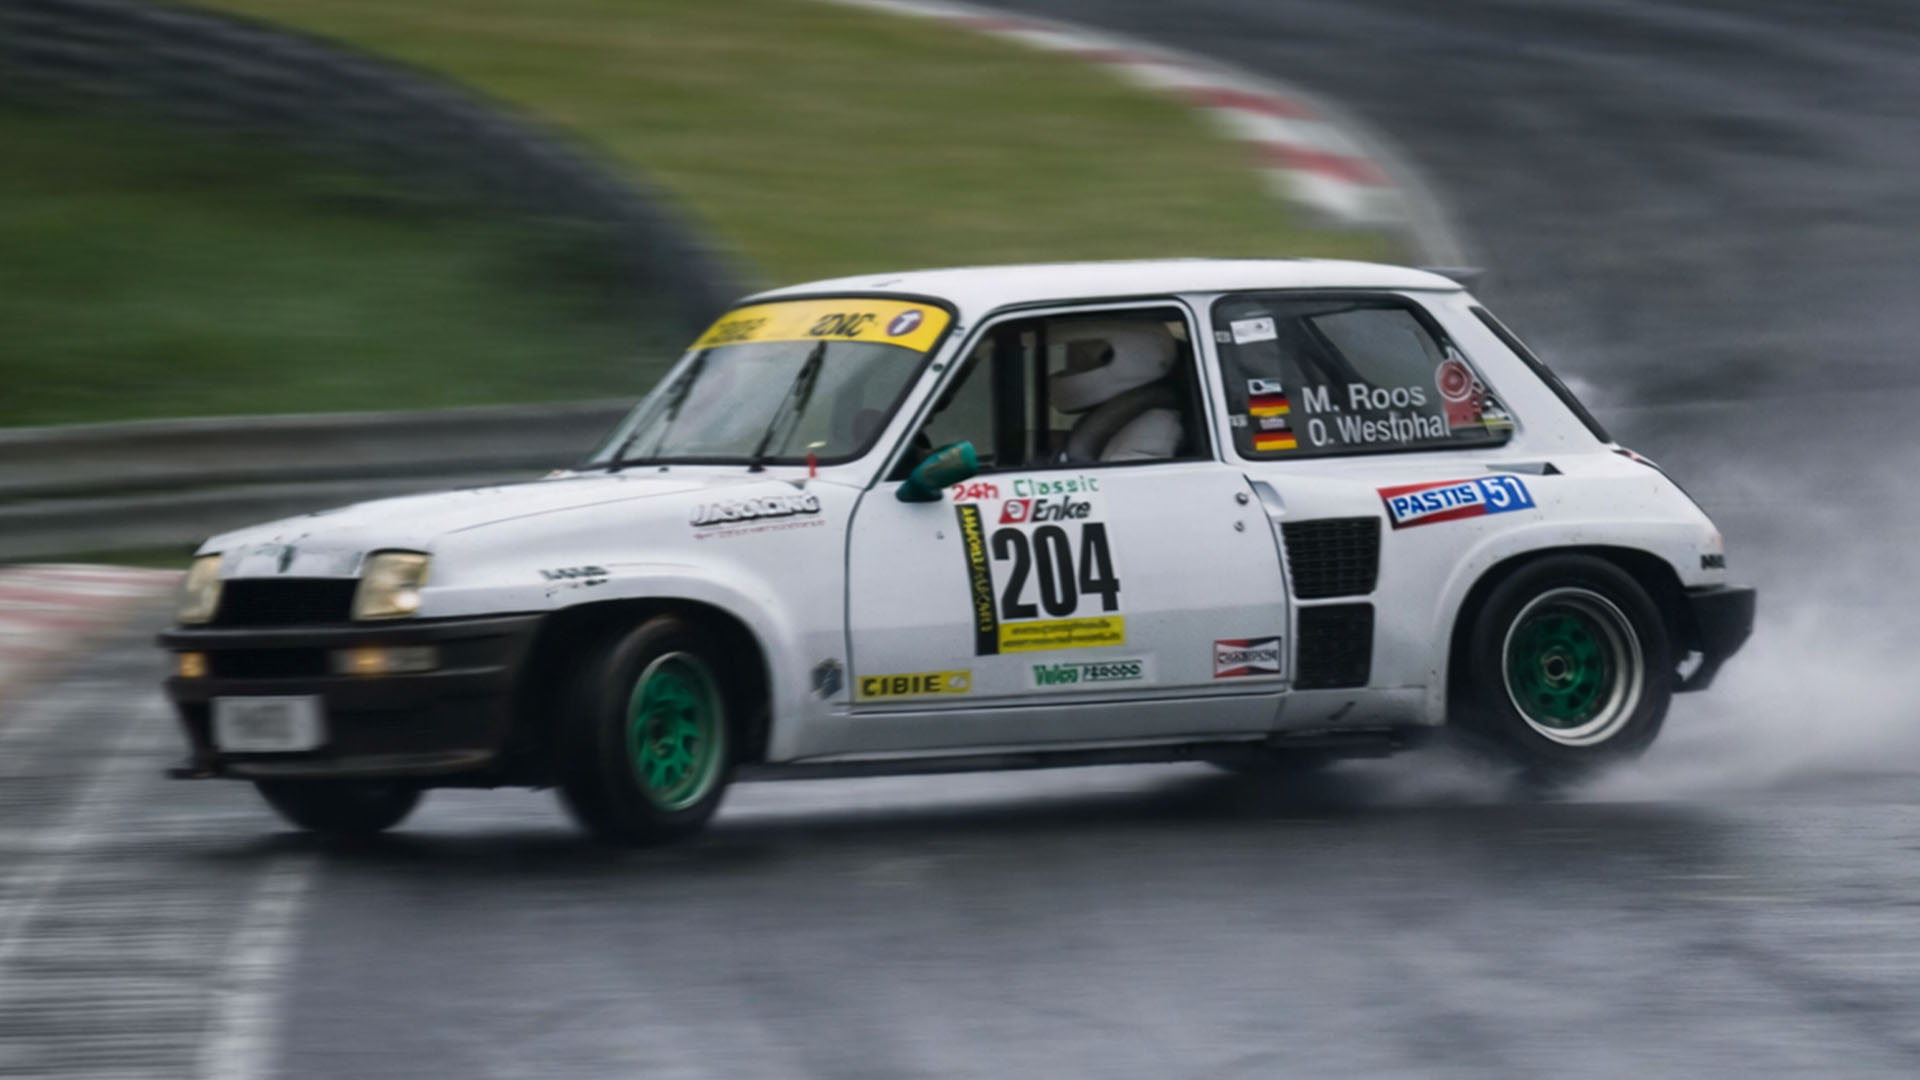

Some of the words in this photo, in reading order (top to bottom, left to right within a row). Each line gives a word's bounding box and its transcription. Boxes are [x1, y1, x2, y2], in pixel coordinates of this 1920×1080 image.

[1302, 384, 1340, 413] M.
[1348, 383, 1427, 410] Roos
[1308, 418, 1334, 446] O.
[1337, 411, 1451, 445] Westphal
[952, 482, 998, 501] 24h
[1014, 476, 1099, 496] Classic
[1392, 485, 1477, 517] PASTIS
[1482, 477, 1527, 508] 51
[1031, 496, 1091, 522] Enke
[991, 523, 1120, 620] 204
[862, 675, 942, 696] CIBIE
